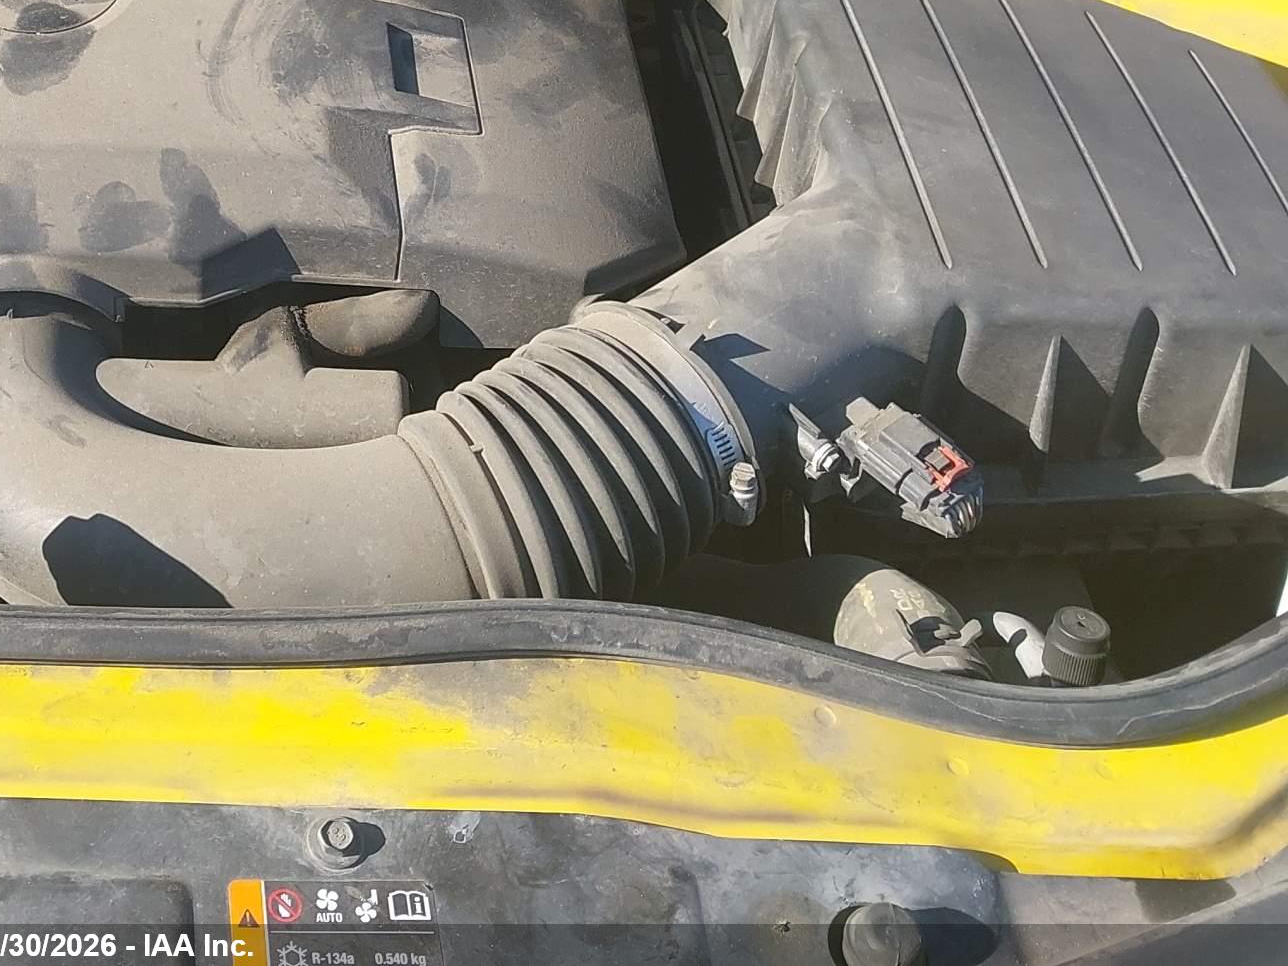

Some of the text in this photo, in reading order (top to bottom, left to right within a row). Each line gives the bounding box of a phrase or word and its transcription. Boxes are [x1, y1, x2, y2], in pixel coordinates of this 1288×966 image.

[316, 912, 343, 923] AUTO
[311, 952, 427, 966] R-134a 0.540 kg
